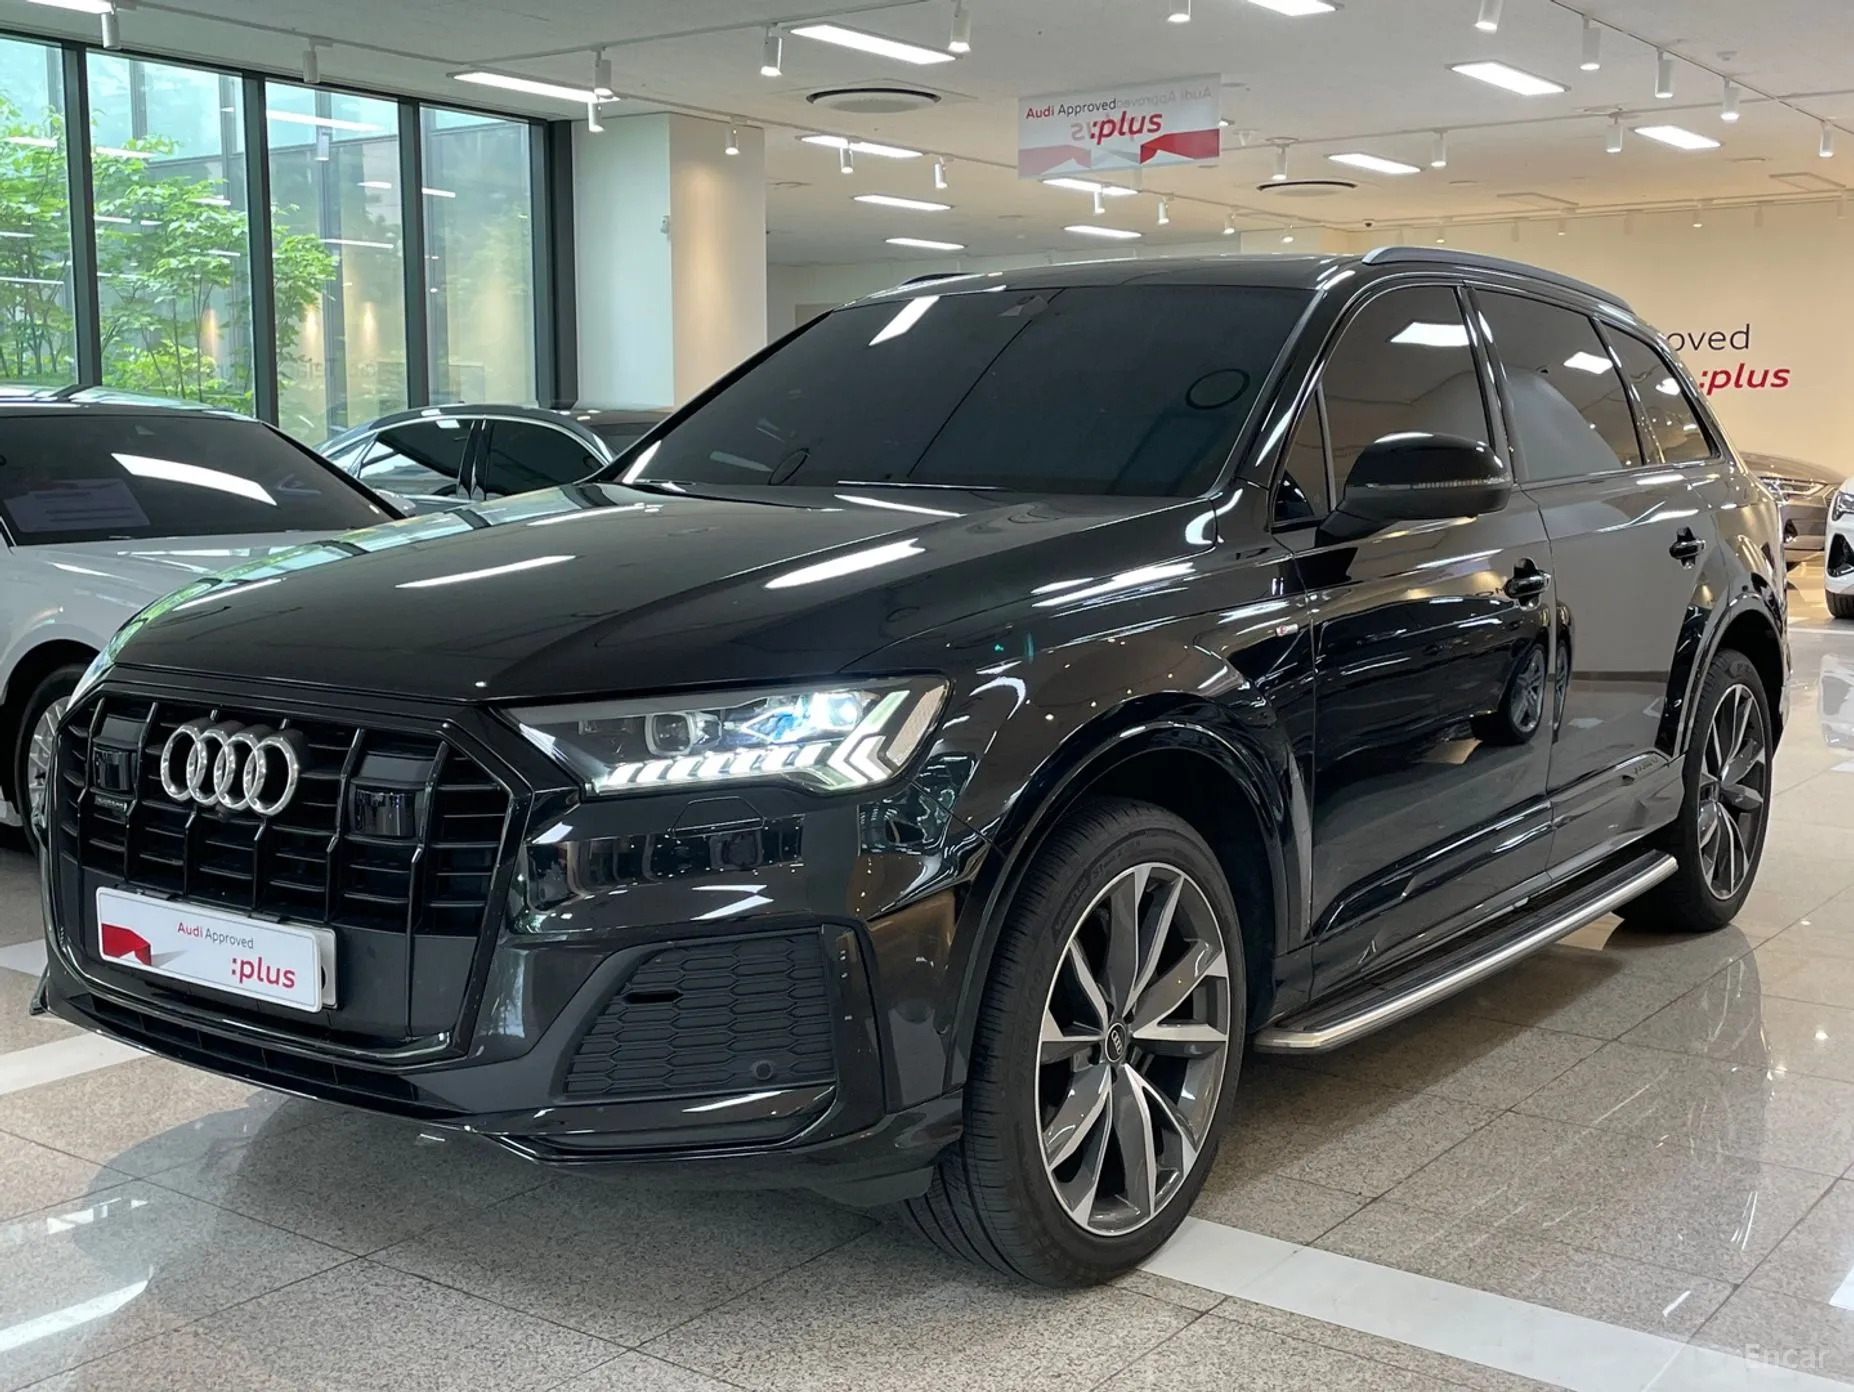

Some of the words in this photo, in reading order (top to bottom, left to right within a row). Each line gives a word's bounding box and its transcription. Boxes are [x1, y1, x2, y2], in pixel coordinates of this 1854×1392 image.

[1026, 104, 1055, 119] Audi
[1057, 98, 1117, 118] Approved
[1090, 111, 1162, 145] :plus
[1667, 323, 1750, 351] oved
[1699, 363, 1791, 396] :plus
[177, 922, 203, 939] Audi
[205, 928, 254, 950] Approved
[231, 956, 296, 989] :plus
